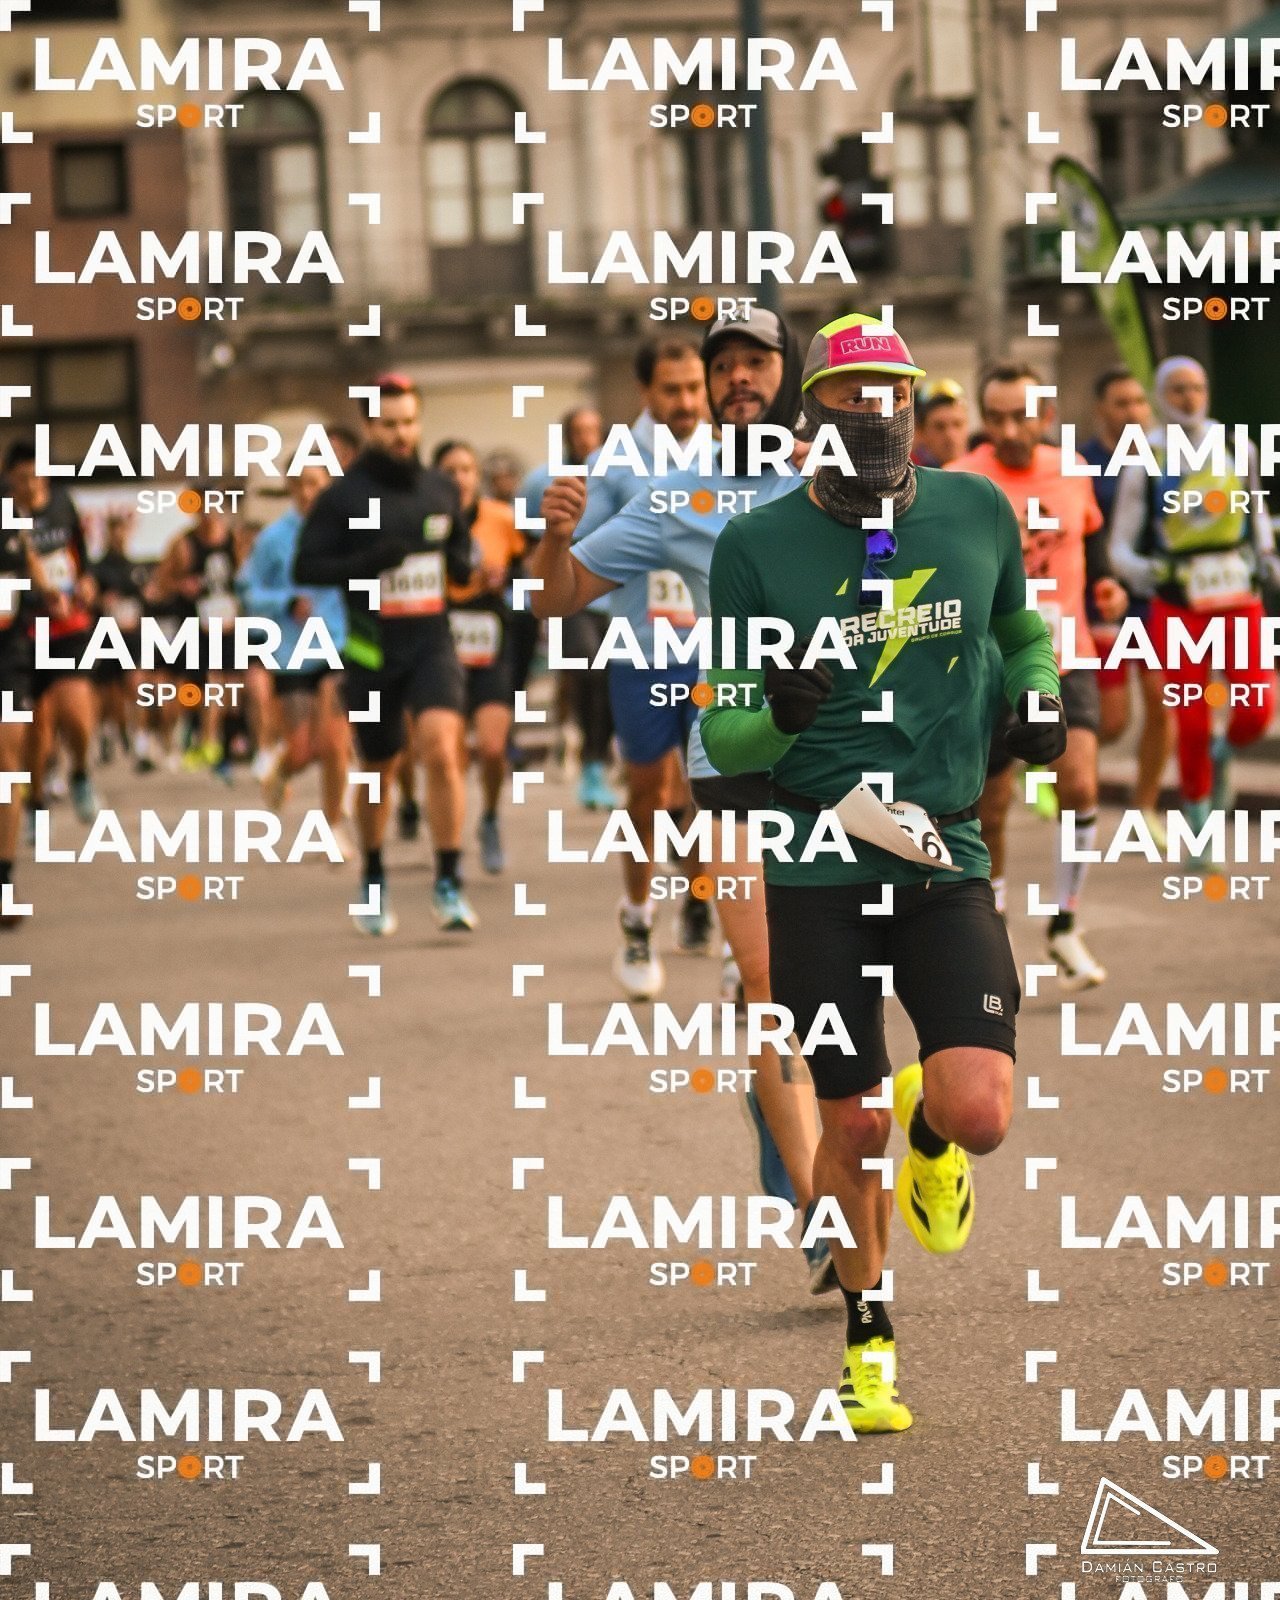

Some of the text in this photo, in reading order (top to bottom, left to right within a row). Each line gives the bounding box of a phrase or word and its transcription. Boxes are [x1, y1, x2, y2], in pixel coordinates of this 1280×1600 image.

[841, 336, 891, 354] RUN
[840, 598, 962, 637] RECREIO
[867, 617, 962, 644] JUVENTUDE
[886, 806, 905, 817] ntel
